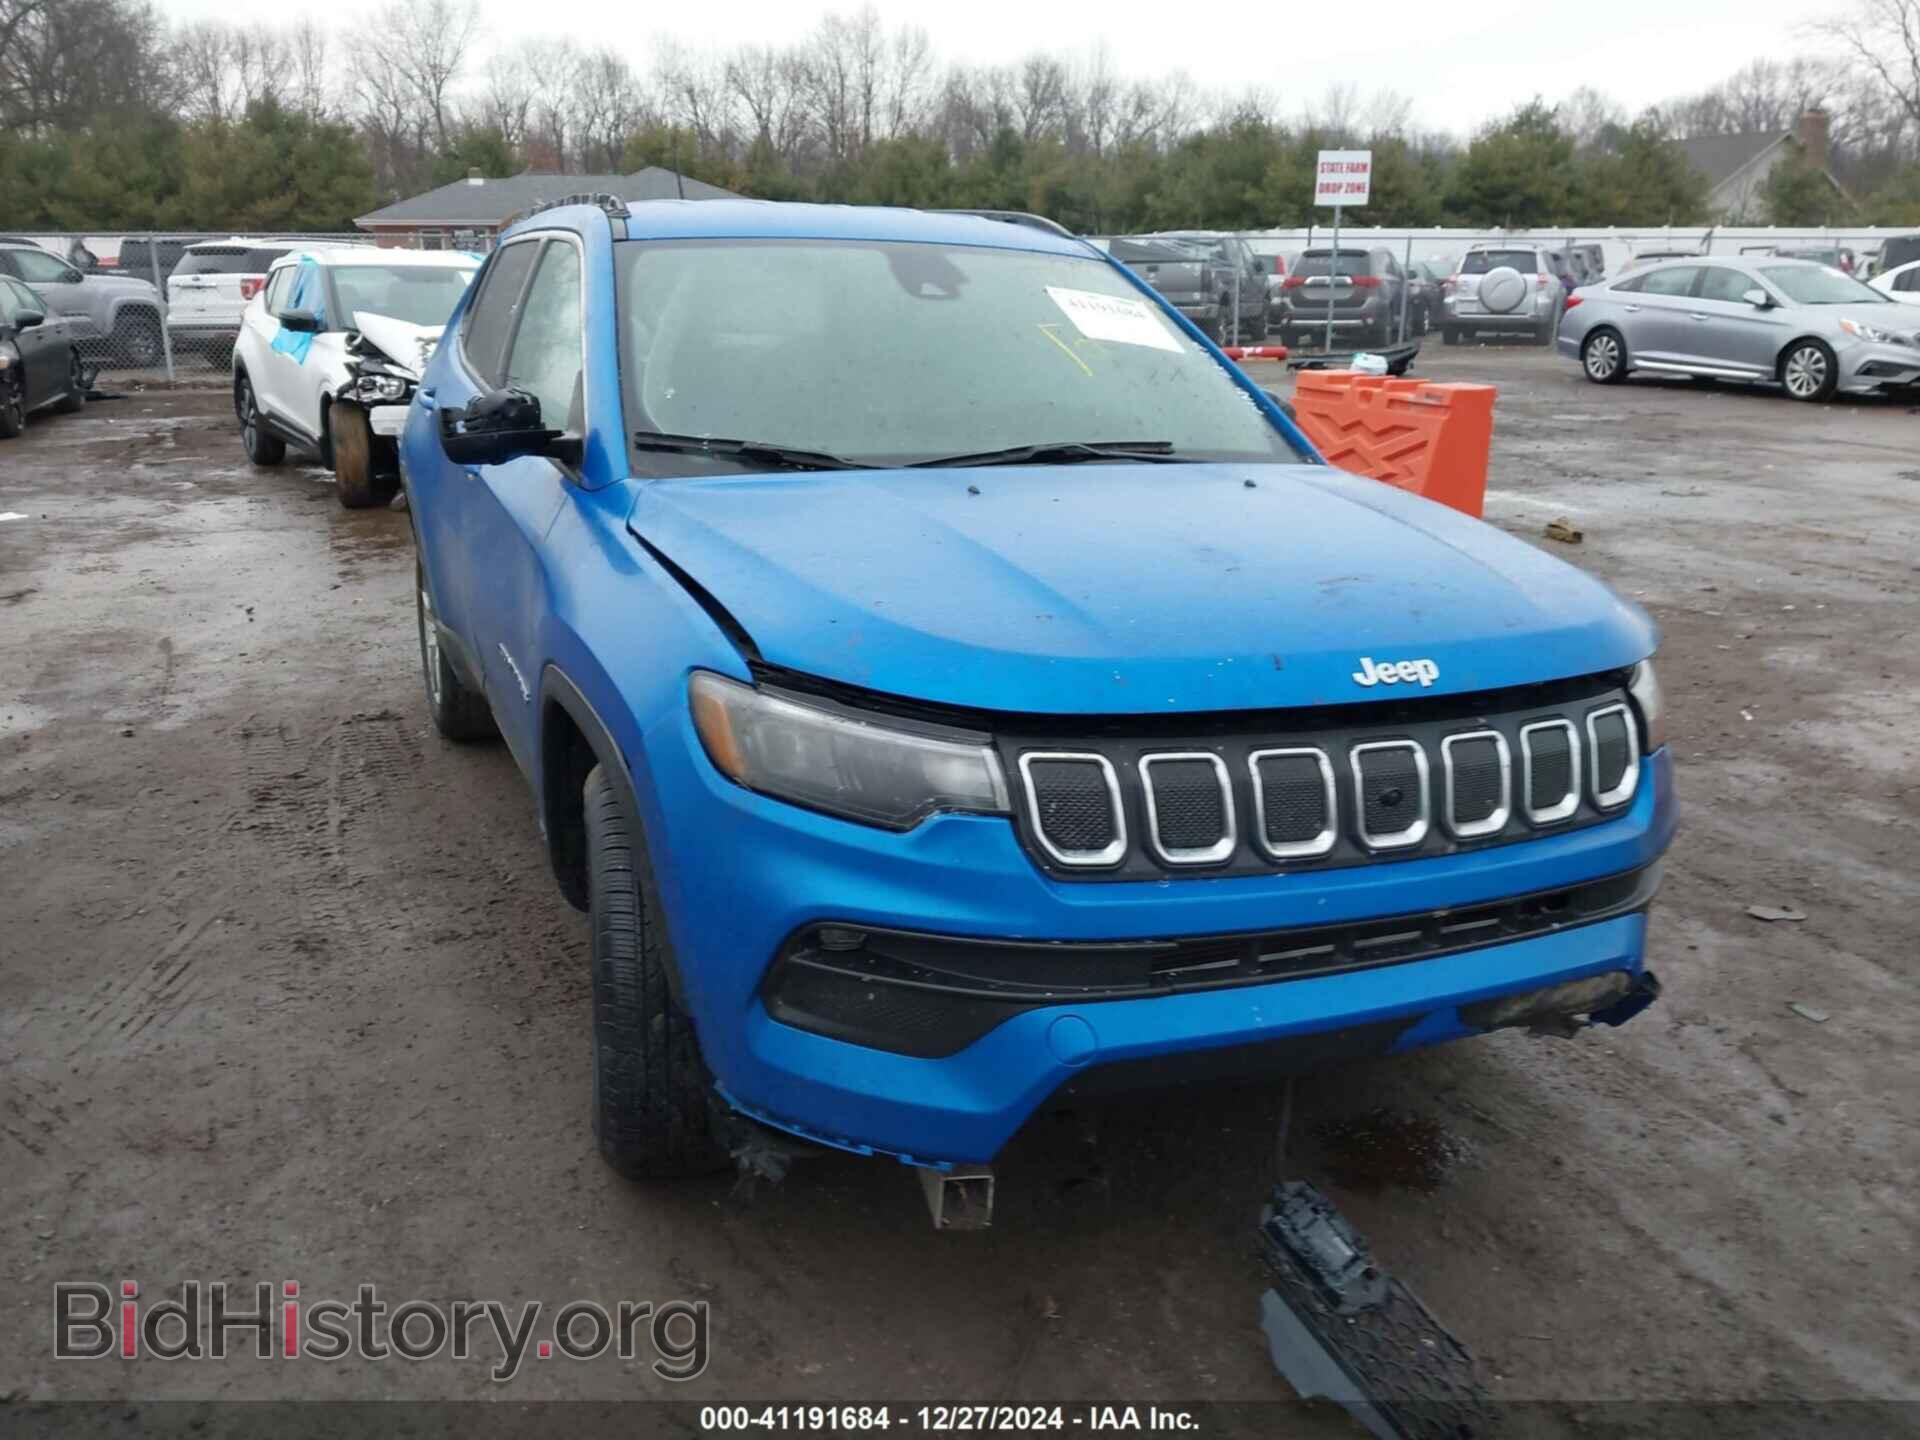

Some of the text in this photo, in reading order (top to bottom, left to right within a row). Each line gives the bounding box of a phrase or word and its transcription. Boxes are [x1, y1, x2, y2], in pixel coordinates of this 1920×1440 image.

[1320, 162, 1368, 173] STATE FARM
[1318, 182, 1366, 193] DROP ZONE
[1352, 656, 1439, 687] Jeep
